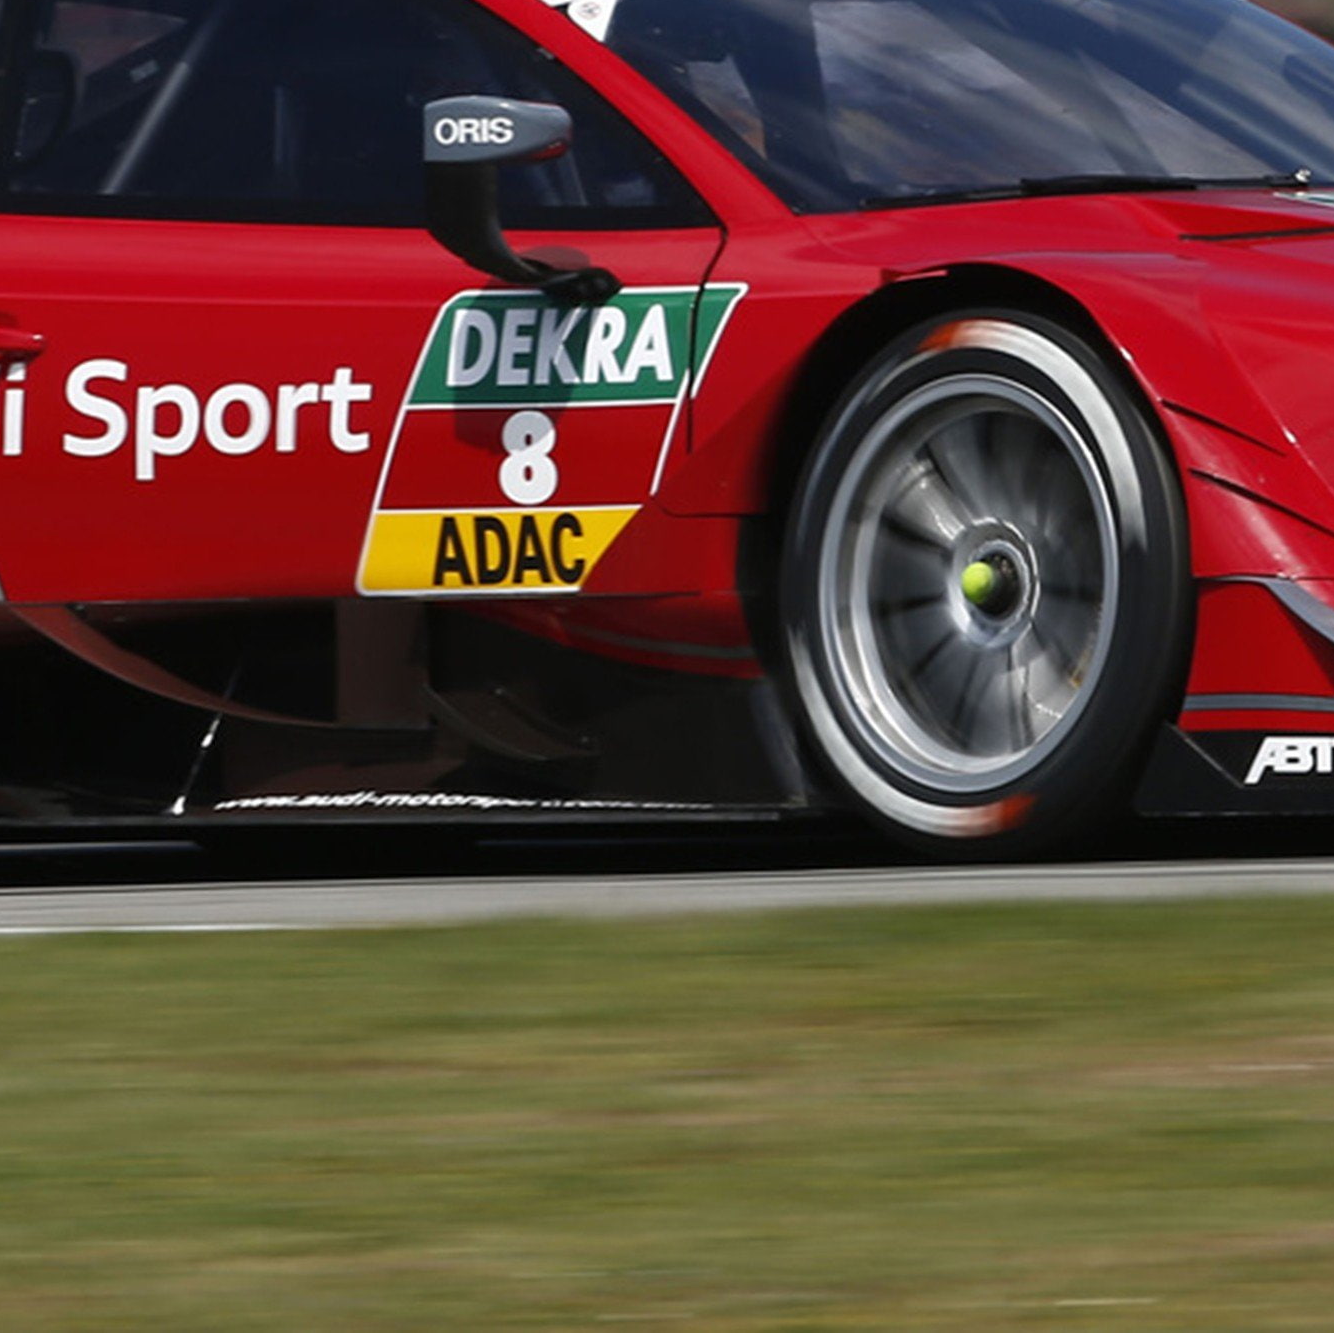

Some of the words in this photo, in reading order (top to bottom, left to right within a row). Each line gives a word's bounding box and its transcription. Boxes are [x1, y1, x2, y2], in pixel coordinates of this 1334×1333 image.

[434, 116, 514, 145] ORIS
[446, 303, 674, 387] DEKRA
[62, 358, 373, 482] Sport
[498, 410, 558, 506] 8
[433, 512, 586, 587] ADAC
